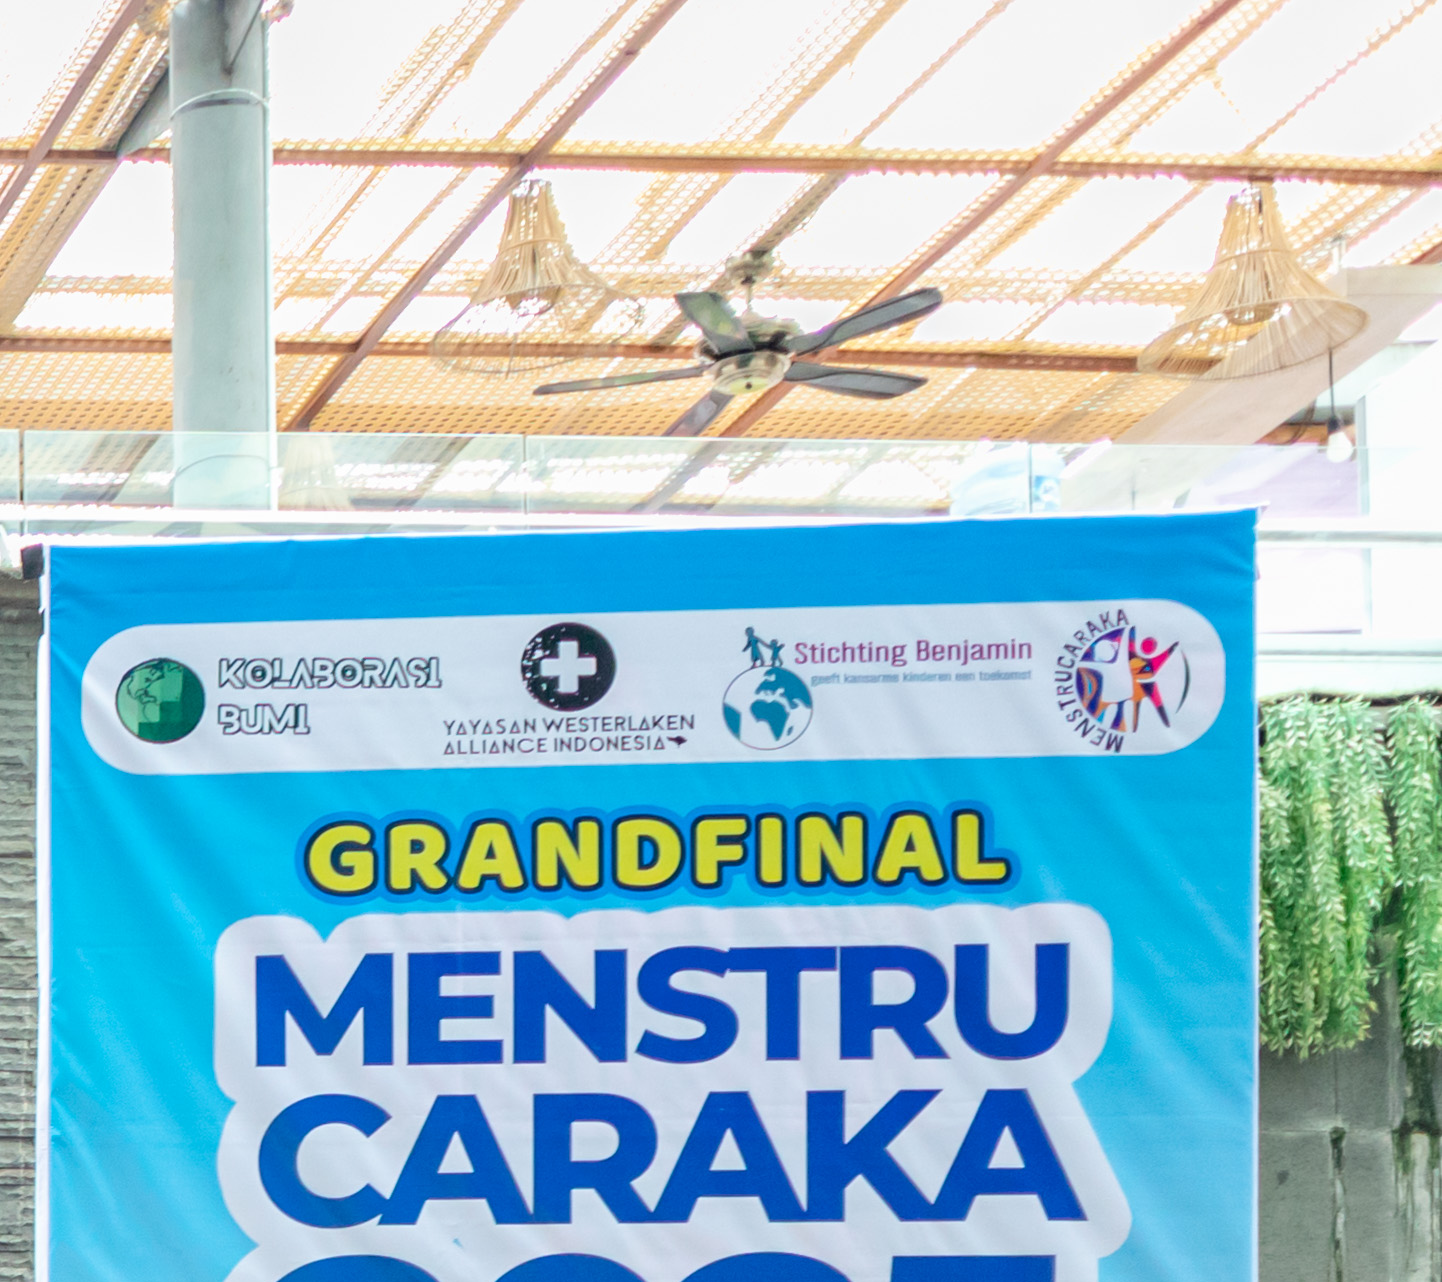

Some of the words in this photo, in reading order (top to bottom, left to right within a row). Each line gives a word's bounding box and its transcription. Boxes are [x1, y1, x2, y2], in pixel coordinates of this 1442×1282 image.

[795, 642, 907, 666] Stichting
[917, 639, 1032, 665] Benjamin
[219, 657, 442, 688] KOLABORASI
[1054, 609, 1130, 753] MENSTRUCARAKA
[218, 704, 311, 735] BUMI
[444, 719, 537, 735] YAYASAN
[542, 715, 694, 733] WESTERLAKEN
[444, 737, 547, 755] ALLIANCE
[555, 735, 666, 752] INDONESIA
[305, 810, 1008, 894] GRANDFINAL
[254, 944, 1071, 1068] MENSTRU
[259, 1089, 1086, 1229] CARAKA
